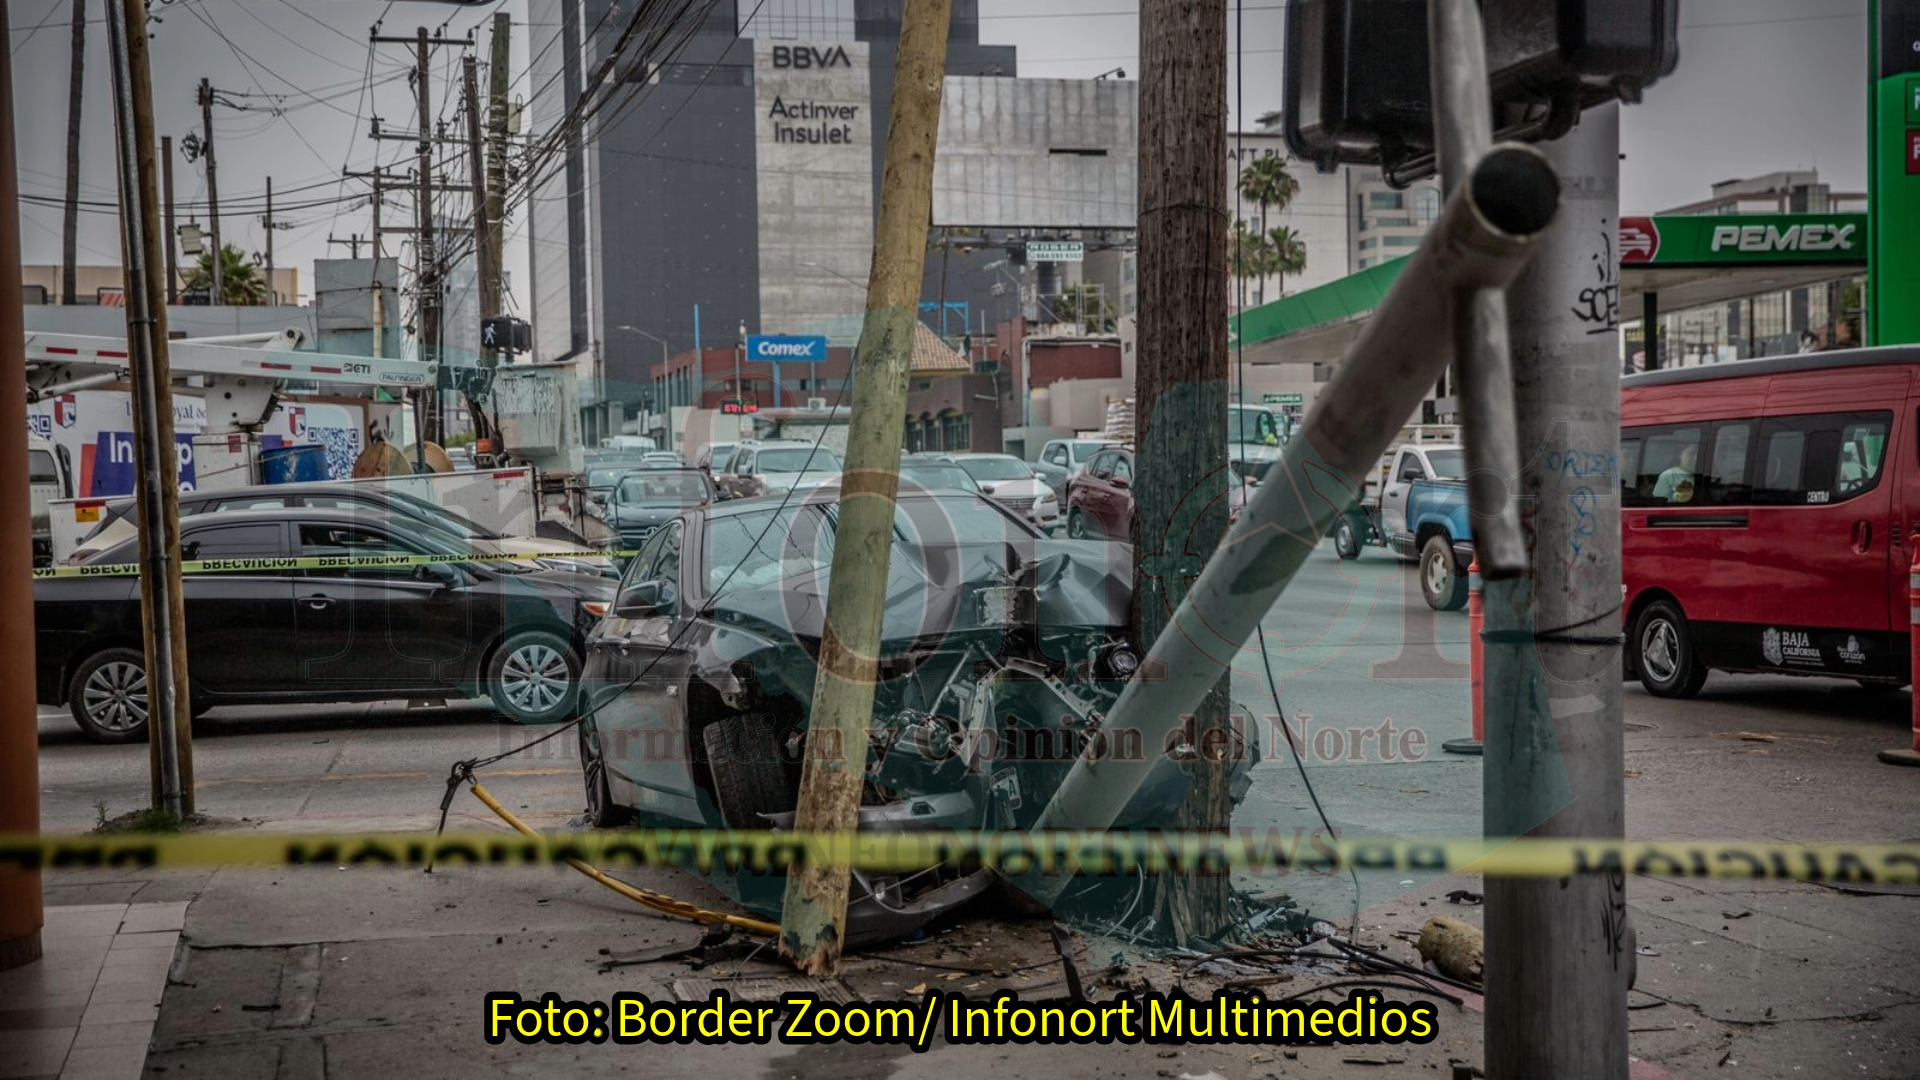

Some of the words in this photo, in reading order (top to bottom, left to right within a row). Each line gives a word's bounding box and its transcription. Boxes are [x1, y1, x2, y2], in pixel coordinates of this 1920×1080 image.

[773, 44, 851, 69] BBVA
[768, 95, 859, 120] Actinver
[775, 121, 852, 144] Insulet
[1228, 148, 1258, 160] ATT
[1265, 149, 1297, 161] PLA
[1711, 224, 1856, 252] PEMEX
[758, 340, 817, 356] Comex
[381, 372, 425, 384] PALFINGER
[1782, 631, 1810, 647] BAJA
[1782, 646, 1821, 658] CALIFORNIA
